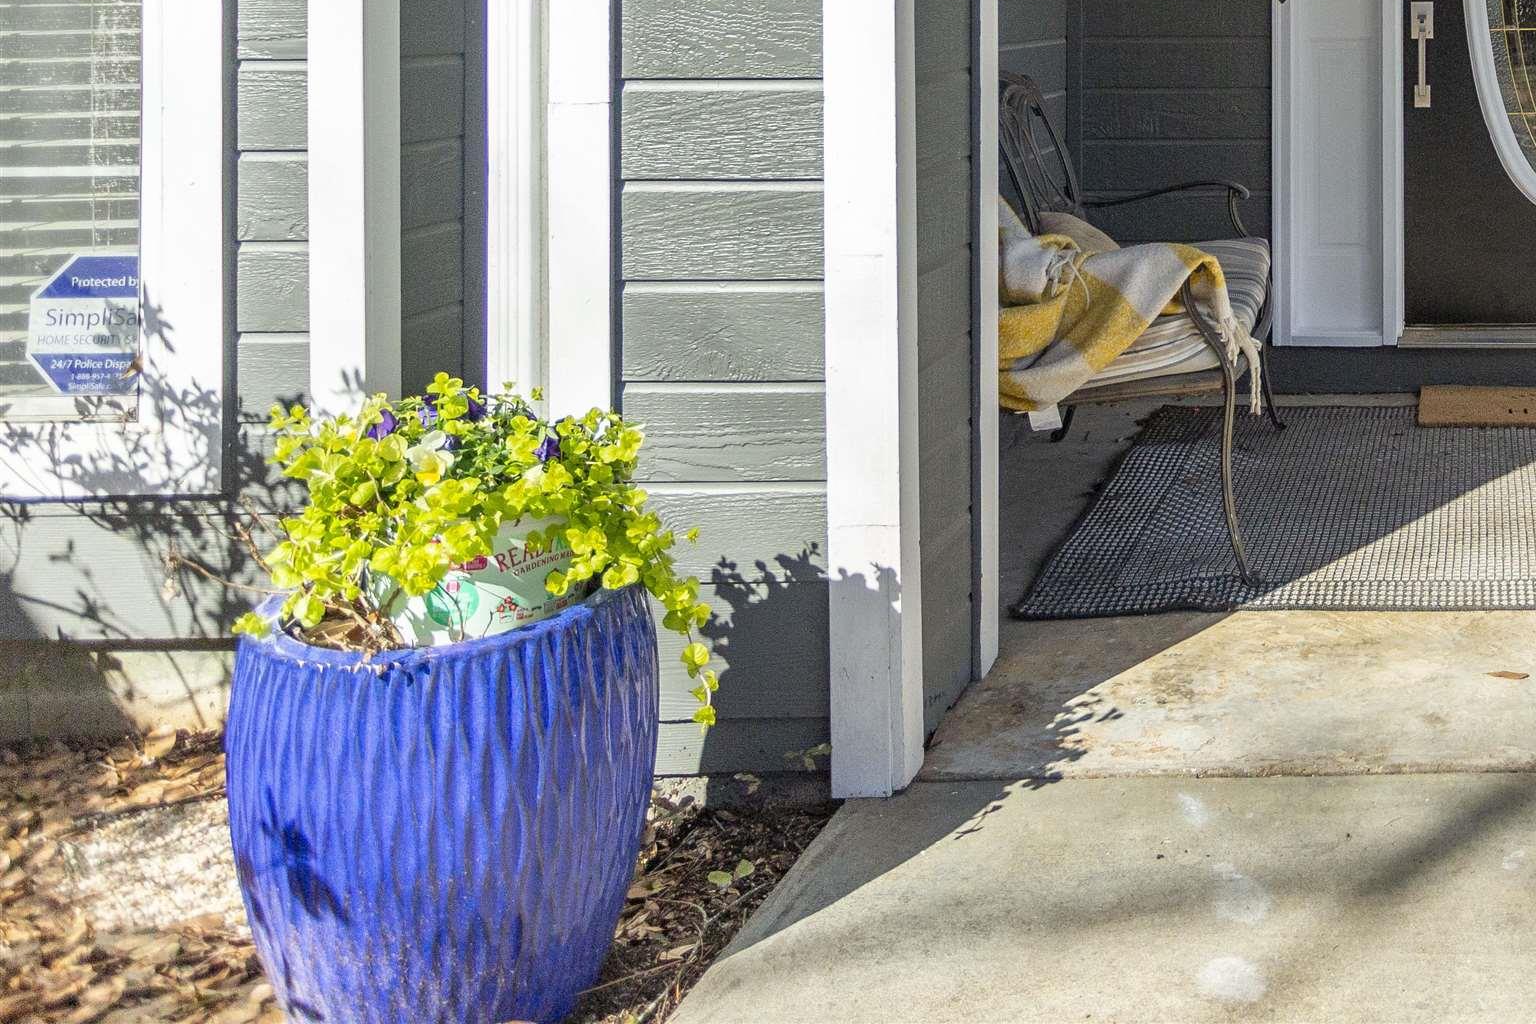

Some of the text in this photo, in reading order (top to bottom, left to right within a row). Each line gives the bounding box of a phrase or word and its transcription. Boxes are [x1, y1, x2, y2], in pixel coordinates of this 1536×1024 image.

[72, 276, 126, 288] Protected
[37, 334, 71, 345] HOME
[73, 334, 121, 345] SECURITY
[51, 359, 72, 370] 24/7
[74, 358, 103, 370] Police
[512, 553, 559, 576] GARDENING
